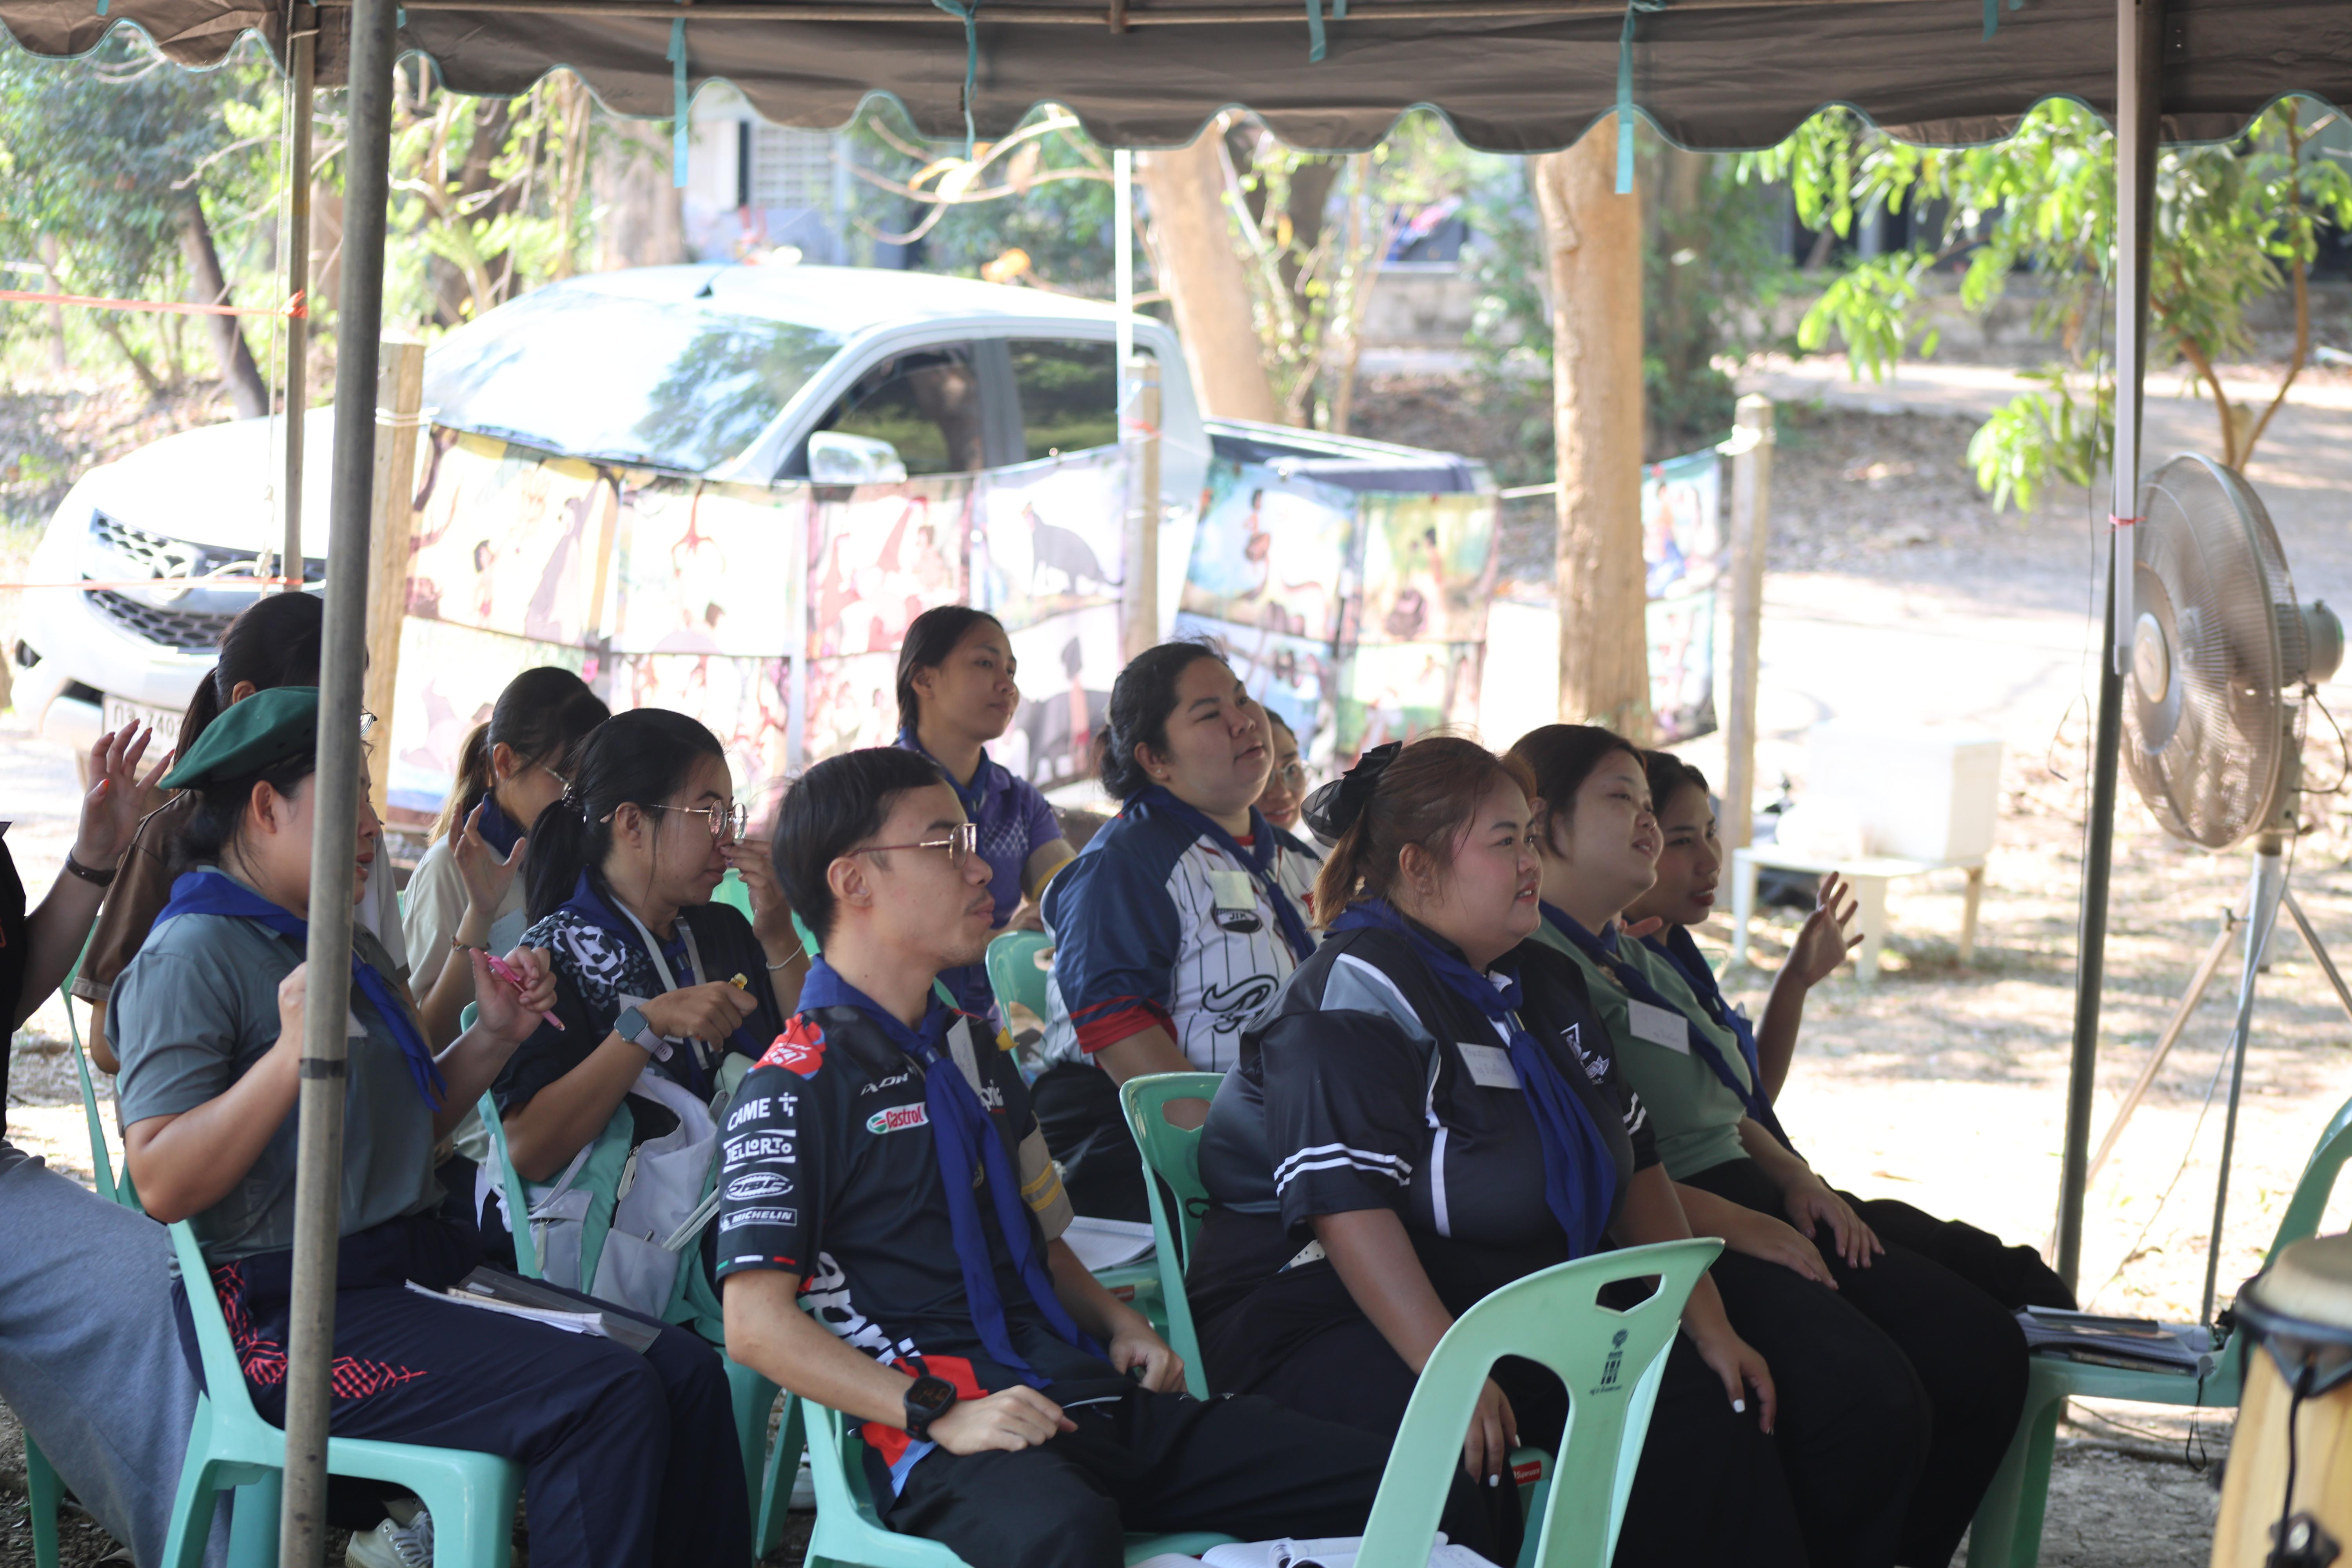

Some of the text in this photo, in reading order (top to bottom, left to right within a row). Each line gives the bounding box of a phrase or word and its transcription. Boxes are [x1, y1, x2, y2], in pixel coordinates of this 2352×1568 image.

[727, 1097, 771, 1131] CAME
[886, 1105, 924, 1128] Castrol
[731, 1210, 792, 1224] MICHELIN
